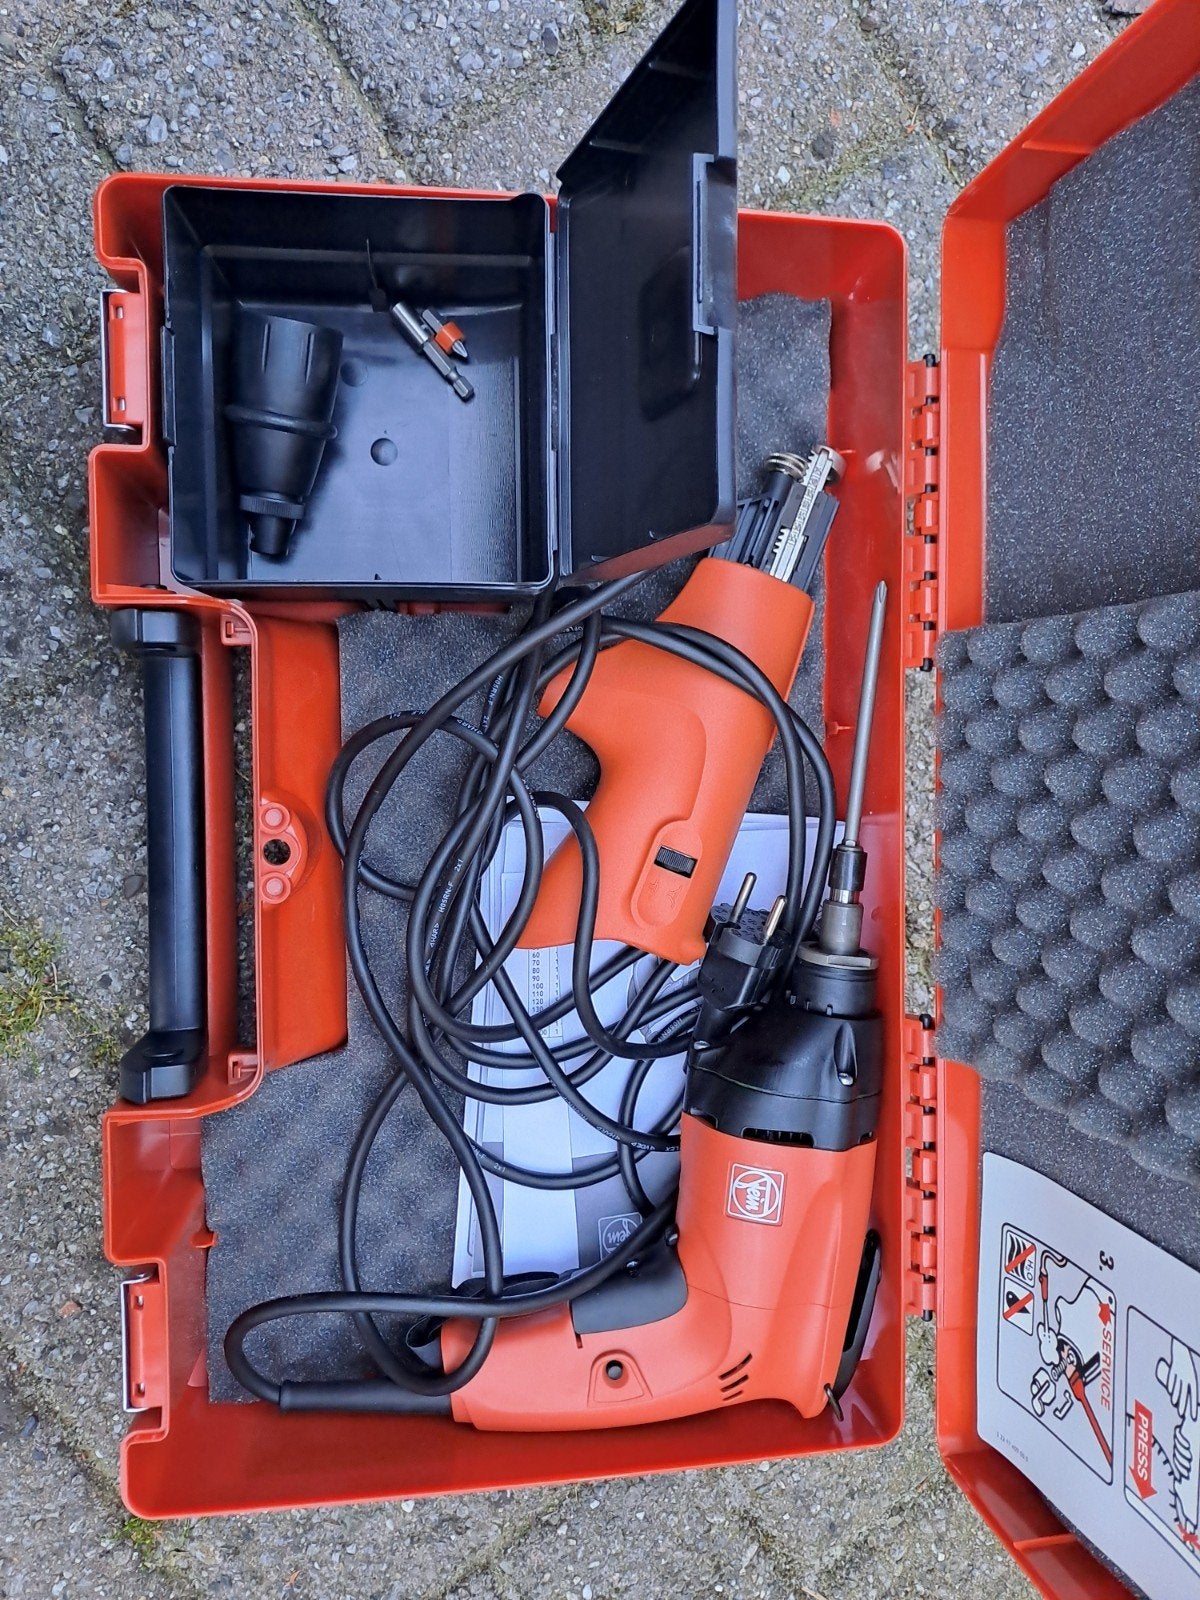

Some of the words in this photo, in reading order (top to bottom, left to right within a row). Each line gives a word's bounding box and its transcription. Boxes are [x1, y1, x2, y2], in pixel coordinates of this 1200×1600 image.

[532, 982, 544, 990] 100
[1100, 1250, 1114, 1272] 3.
[1100, 1327, 1113, 1411] SERVICE
[1137, 1411, 1150, 1480] PRESS
